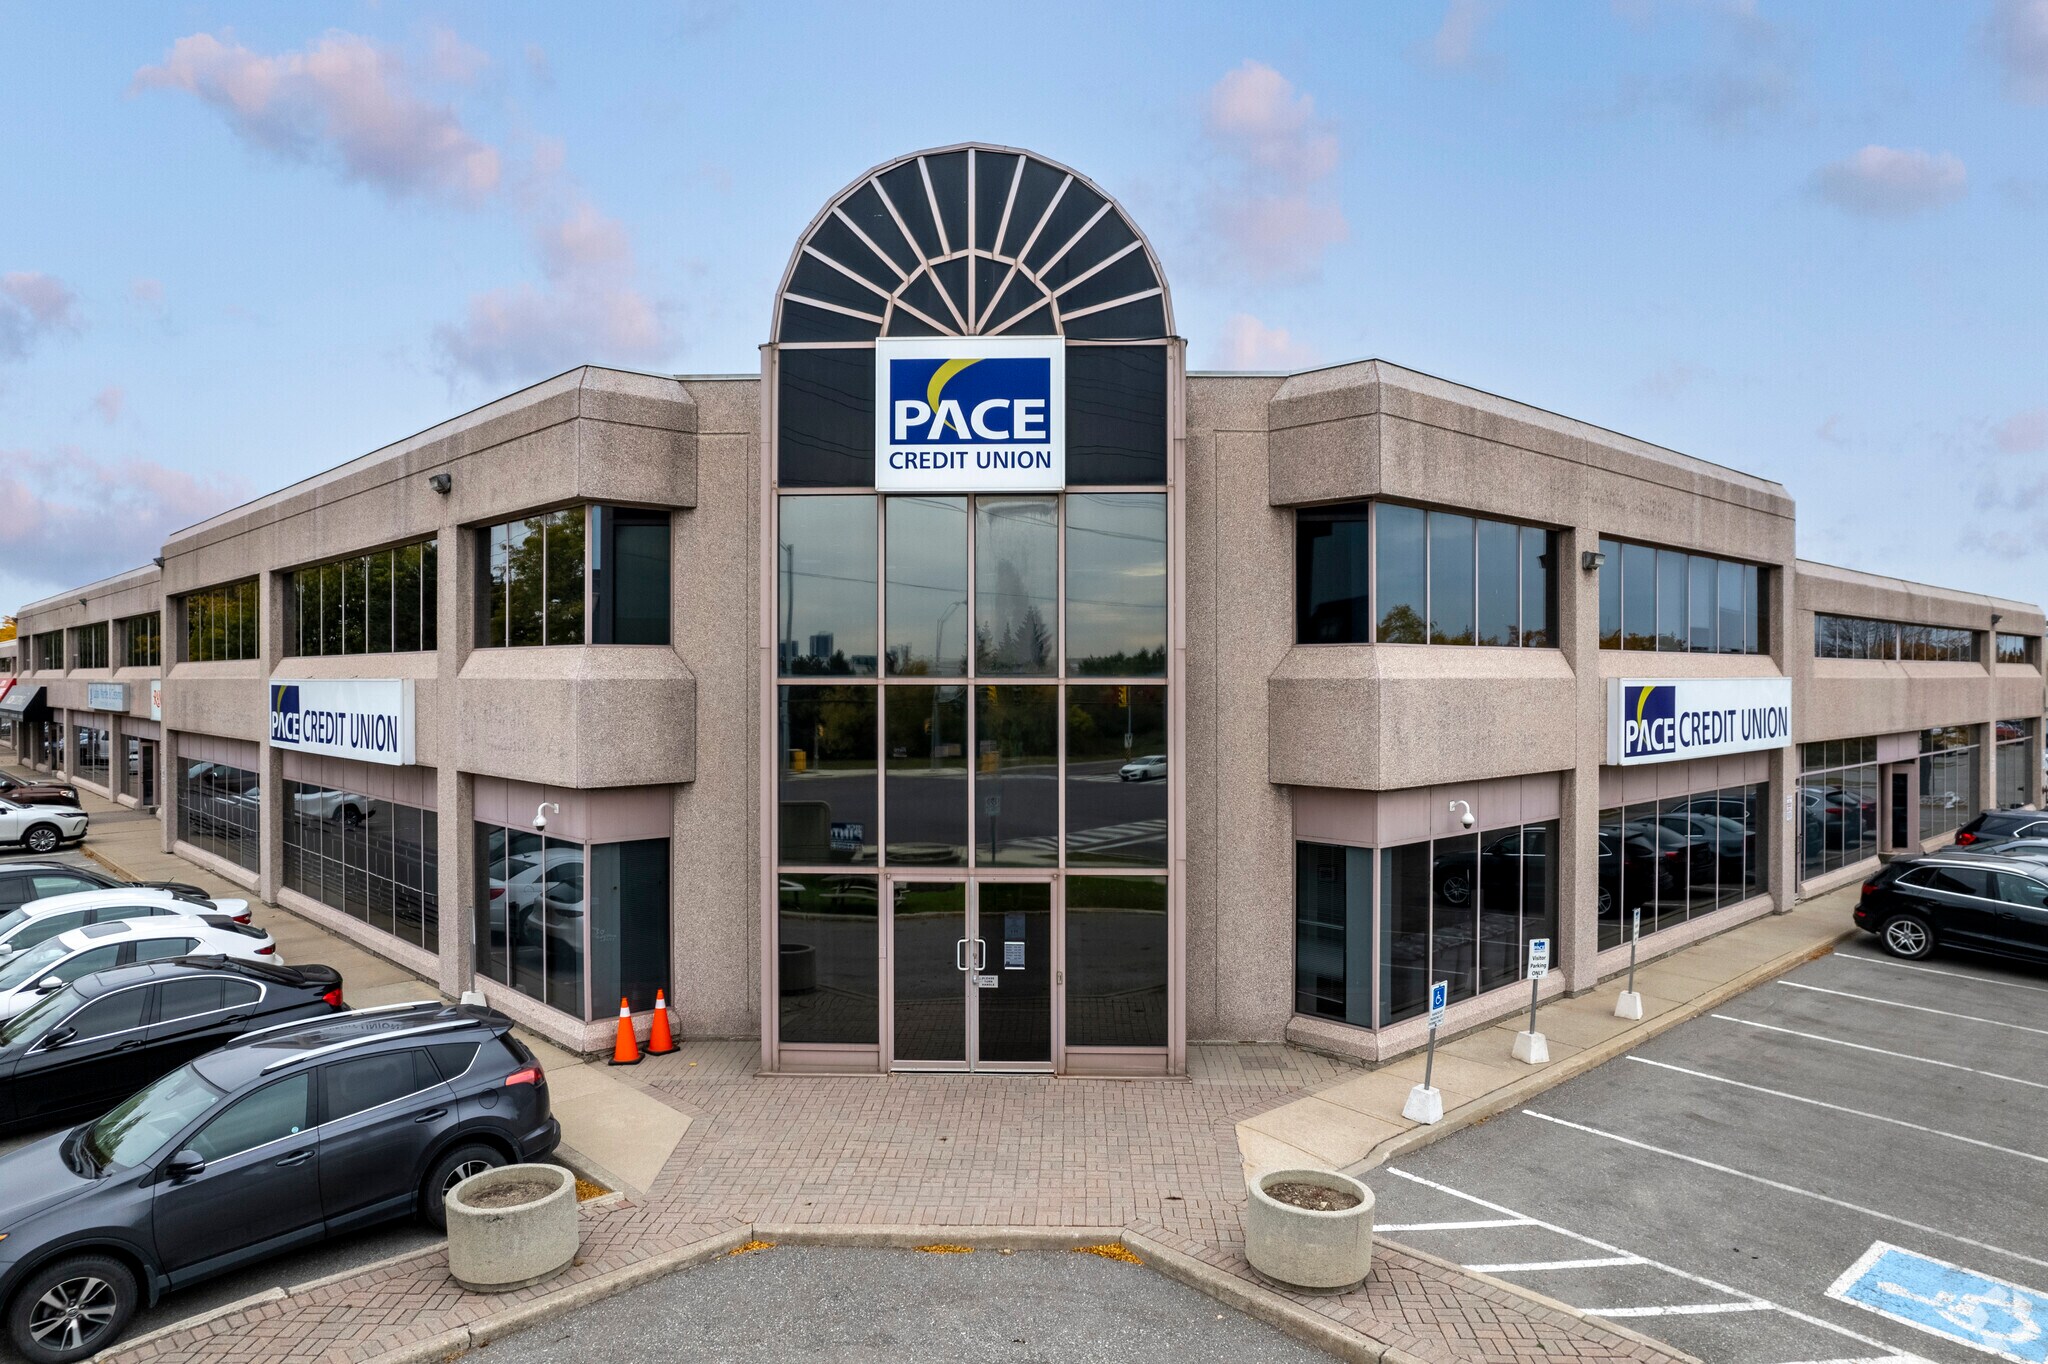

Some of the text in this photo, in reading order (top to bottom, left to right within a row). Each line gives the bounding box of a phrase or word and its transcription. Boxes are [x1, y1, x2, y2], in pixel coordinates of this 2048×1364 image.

[894, 398, 1047, 440] PACE
[889, 450, 1051, 469] CREDIT UNION
[271, 709, 398, 753] PACE CREDIT UNION
[1625, 706, 1788, 754] PACE CREDIT UNION
